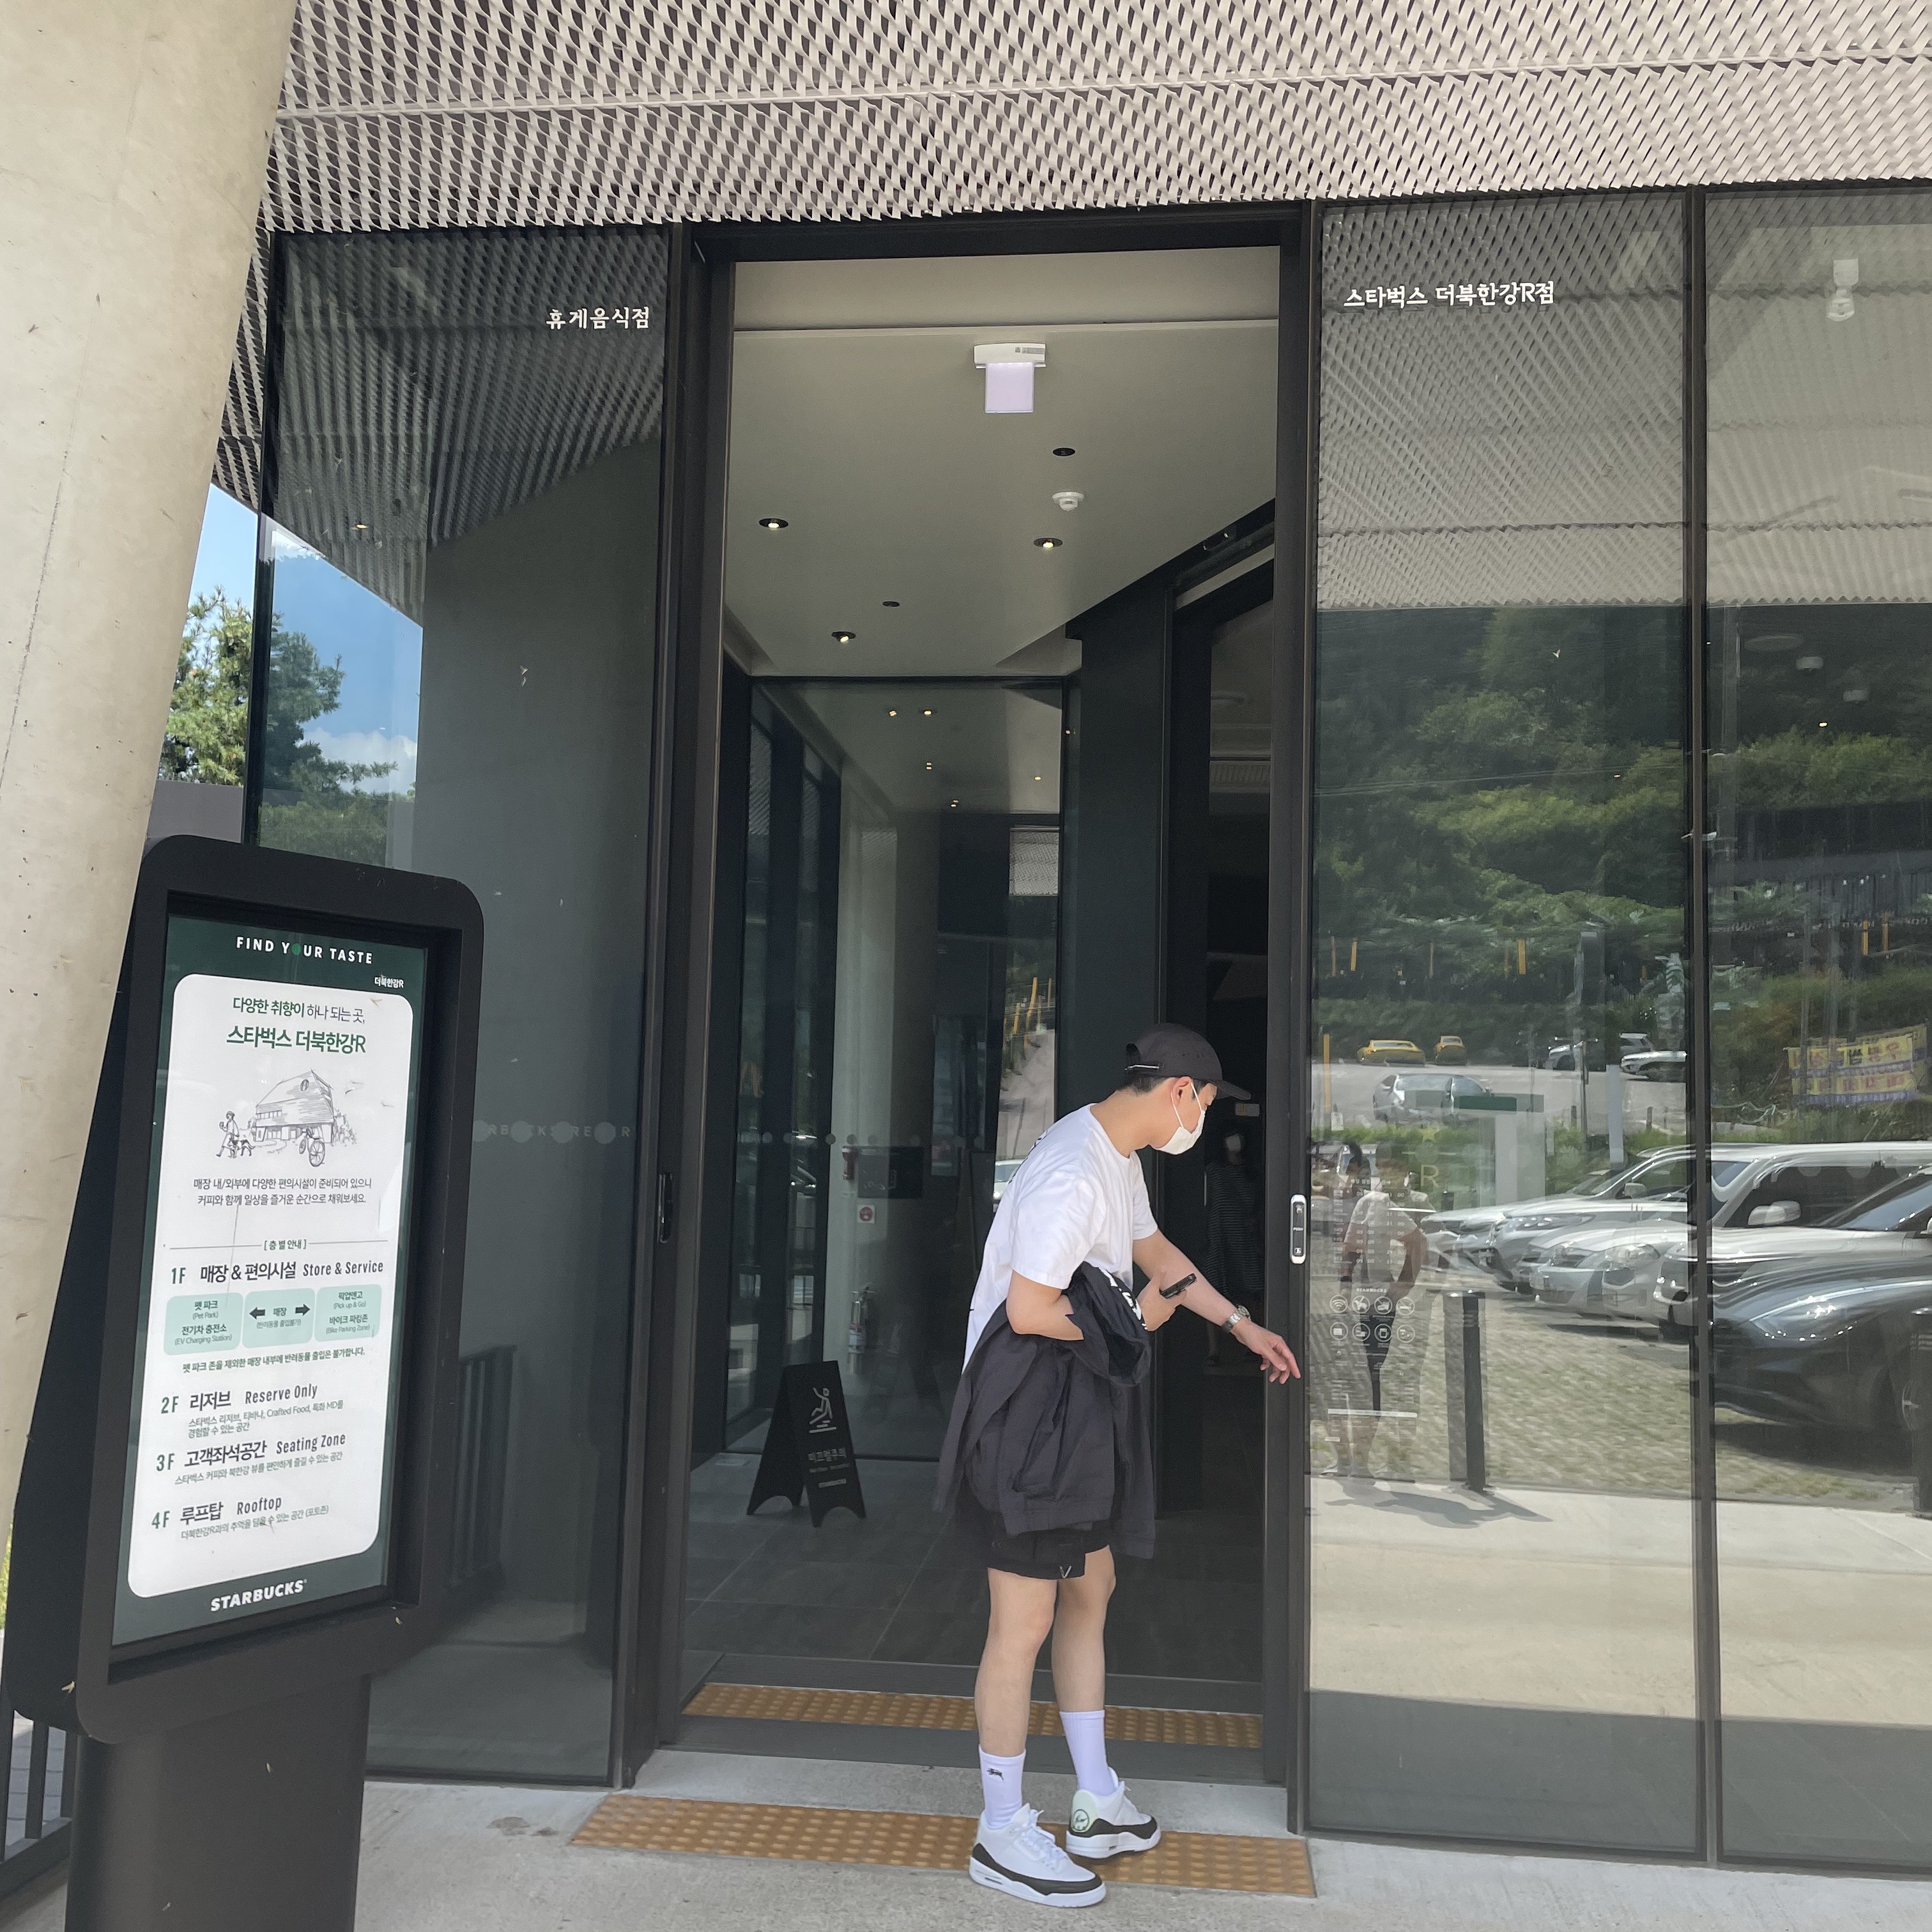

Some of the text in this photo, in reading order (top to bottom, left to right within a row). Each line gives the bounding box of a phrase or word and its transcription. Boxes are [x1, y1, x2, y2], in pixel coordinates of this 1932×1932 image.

[1344, 280, 1554, 309] 스타벅스 더북한강R점
[546, 306, 649, 330] 휴게음식점
[236, 936, 274, 952] FIND
[330, 947, 373, 964] TASTE
[374, 977, 404, 988] 더북한강R
[233, 997, 269, 1014] 다양한
[271, 1000, 305, 1018] 취향이
[307, 1004, 328, 1020] 하나
[330, 1006, 350, 1023] 되는
[226, 1026, 366, 1055] 스타벅스 더북한강R
[194, 1178, 372, 1190] 매장 내/외부에 다양한 편의시설이 준비되어 있으니
[197, 1195, 224, 1206] 커피와
[225, 1195, 242, 1206] 함께
[244, 1194, 268, 1206] 일상을
[270, 1194, 294, 1205] 즐거운
[296, 1193, 326, 1205] 순간으로
[171, 1260, 384, 1284] 1F 매장 & 편의시설 Store & Service
[194, 1300, 218, 1311] 펫 파크
[181, 1323, 227, 1335] 전기차 충전소
[329, 1314, 369, 1325] 바이크 파킹존
[183, 1363, 191, 1373] 펫
[192, 1361, 207, 1372] 파크
[208, 1360, 223, 1370] 존을
[224, 1358, 246, 1368] 제외한
[247, 1356, 262, 1367] 매장
[263, 1354, 283, 1365] 내부에
[284, 1351, 310, 1363] 반려동물
[312, 1349, 332, 1361] 출입은
[161, 1383, 318, 1414] 2F 리저브 Reserve Only
[188, 1416, 217, 1427] 스타벅스
[211, 1425, 218, 1436] 수
[220, 1424, 234, 1435] 있는
[236, 1422, 250, 1433] 공간
[156, 1434, 346, 1472] 3F 고객좌석공간 Seating Zone
[174, 1472, 204, 1485] 스타벅스
[206, 1468, 227, 1480] 커피와
[308, 1455, 315, 1465] 수
[316, 1453, 329, 1464] 있는
[330, 1450, 343, 1462] 공간
[151, 1497, 282, 1529] 4F 루프탑 Rooftop
[276, 1512, 289, 1523] 있는
[291, 1509, 304, 1521] 공간
